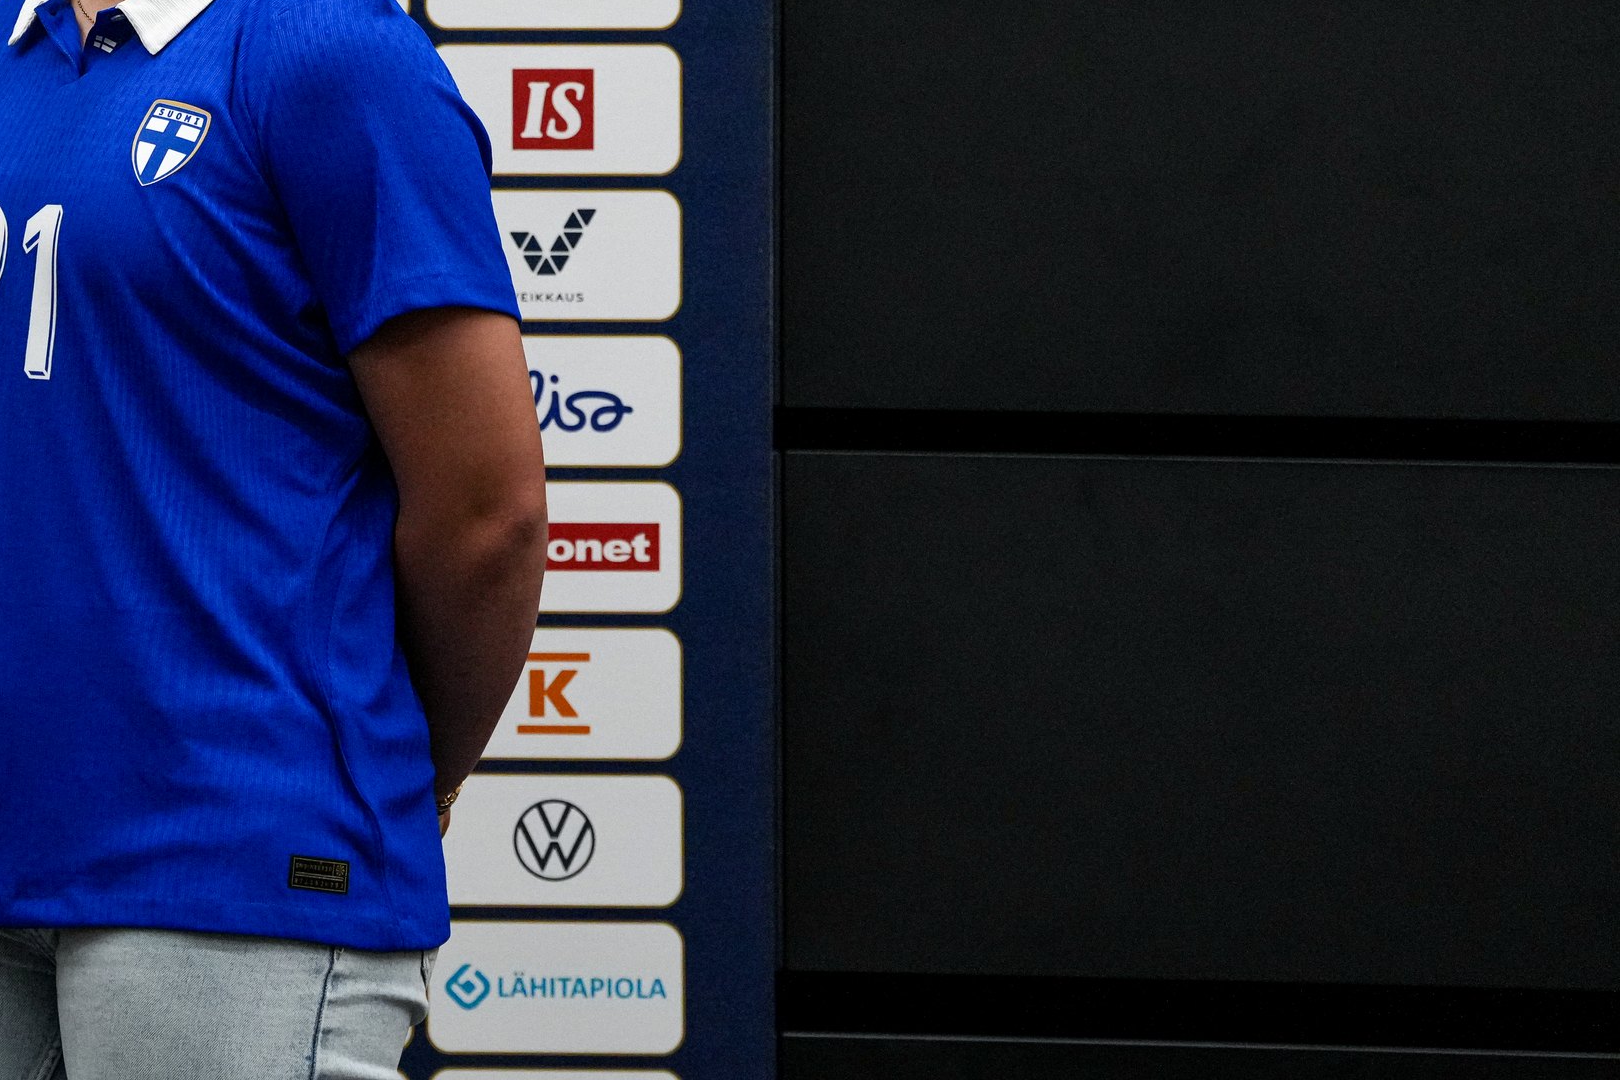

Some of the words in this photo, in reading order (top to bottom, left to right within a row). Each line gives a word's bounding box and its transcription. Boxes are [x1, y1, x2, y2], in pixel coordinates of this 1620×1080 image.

[159, 108, 200, 125] SUOMI
[520, 81, 585, 140] IS
[516, 293, 585, 303] EIKKAUS
[547, 532, 651, 563] onet
[529, 669, 578, 718] K
[497, 972, 667, 1000] LÄHITAPIOLA
